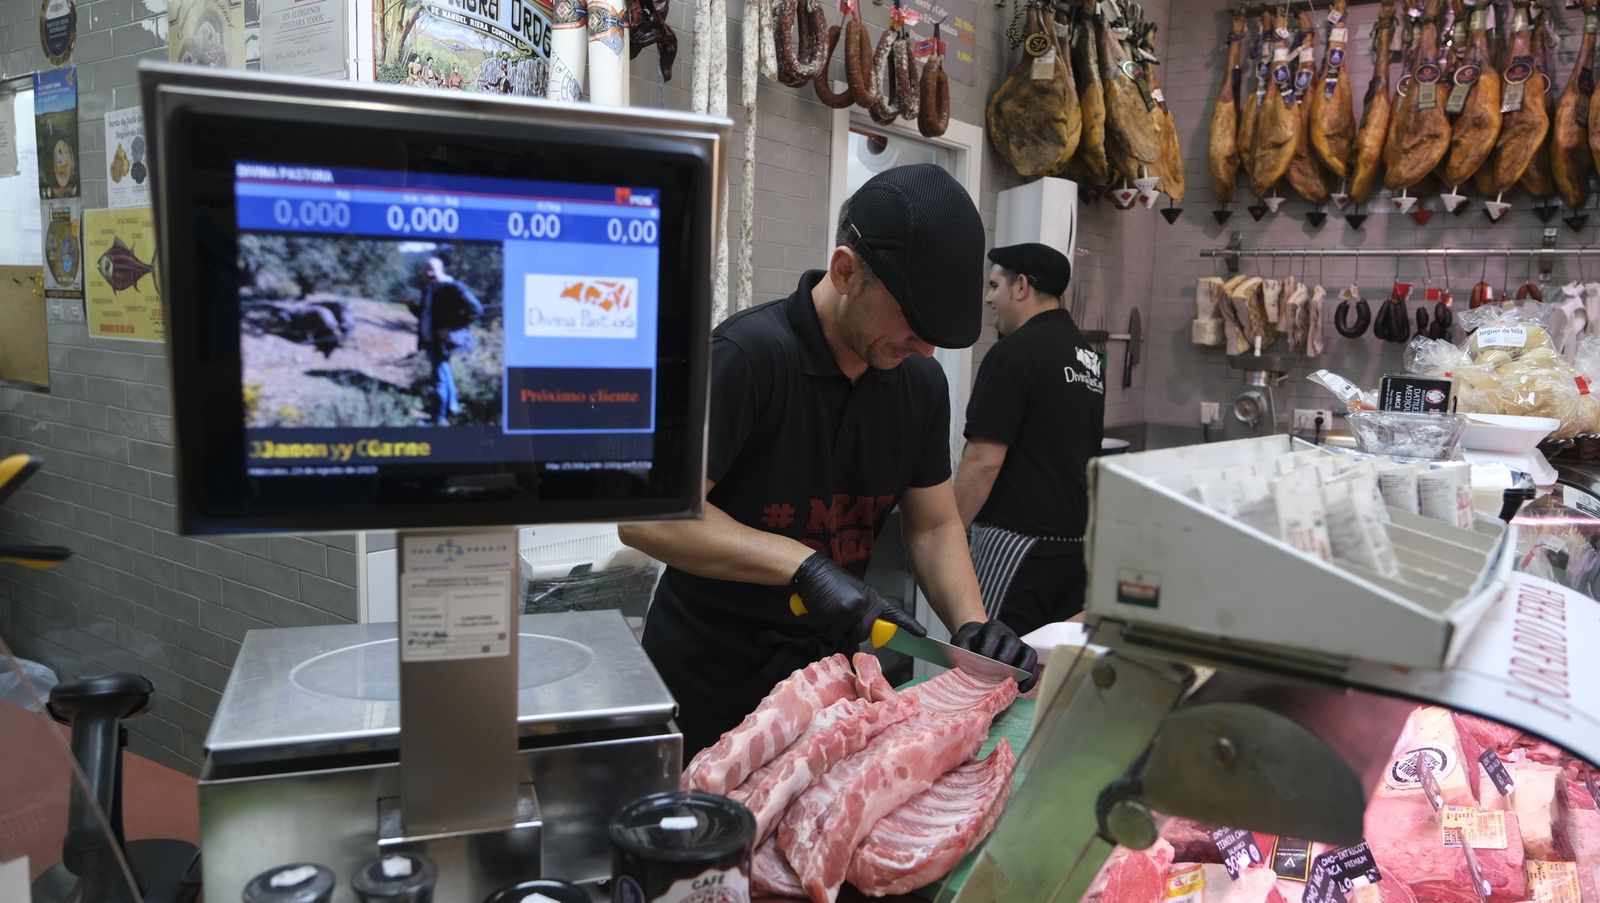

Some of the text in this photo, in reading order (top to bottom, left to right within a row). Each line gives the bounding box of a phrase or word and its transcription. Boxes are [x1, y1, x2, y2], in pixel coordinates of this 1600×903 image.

[306, 14, 324, 25] TODOS
[431, 6, 440, 15] DE
[441, 9, 468, 24] MANUEL
[469, 19, 489, 31] RIERA
[274, 198, 351, 228] 0,000
[386, 205, 459, 234] 0,000
[508, 211, 561, 239] 0,00
[607, 217, 658, 244] 0,00
[589, 388, 639, 403] cliente
[1343, 855, 1368, 870] PREMIUM
